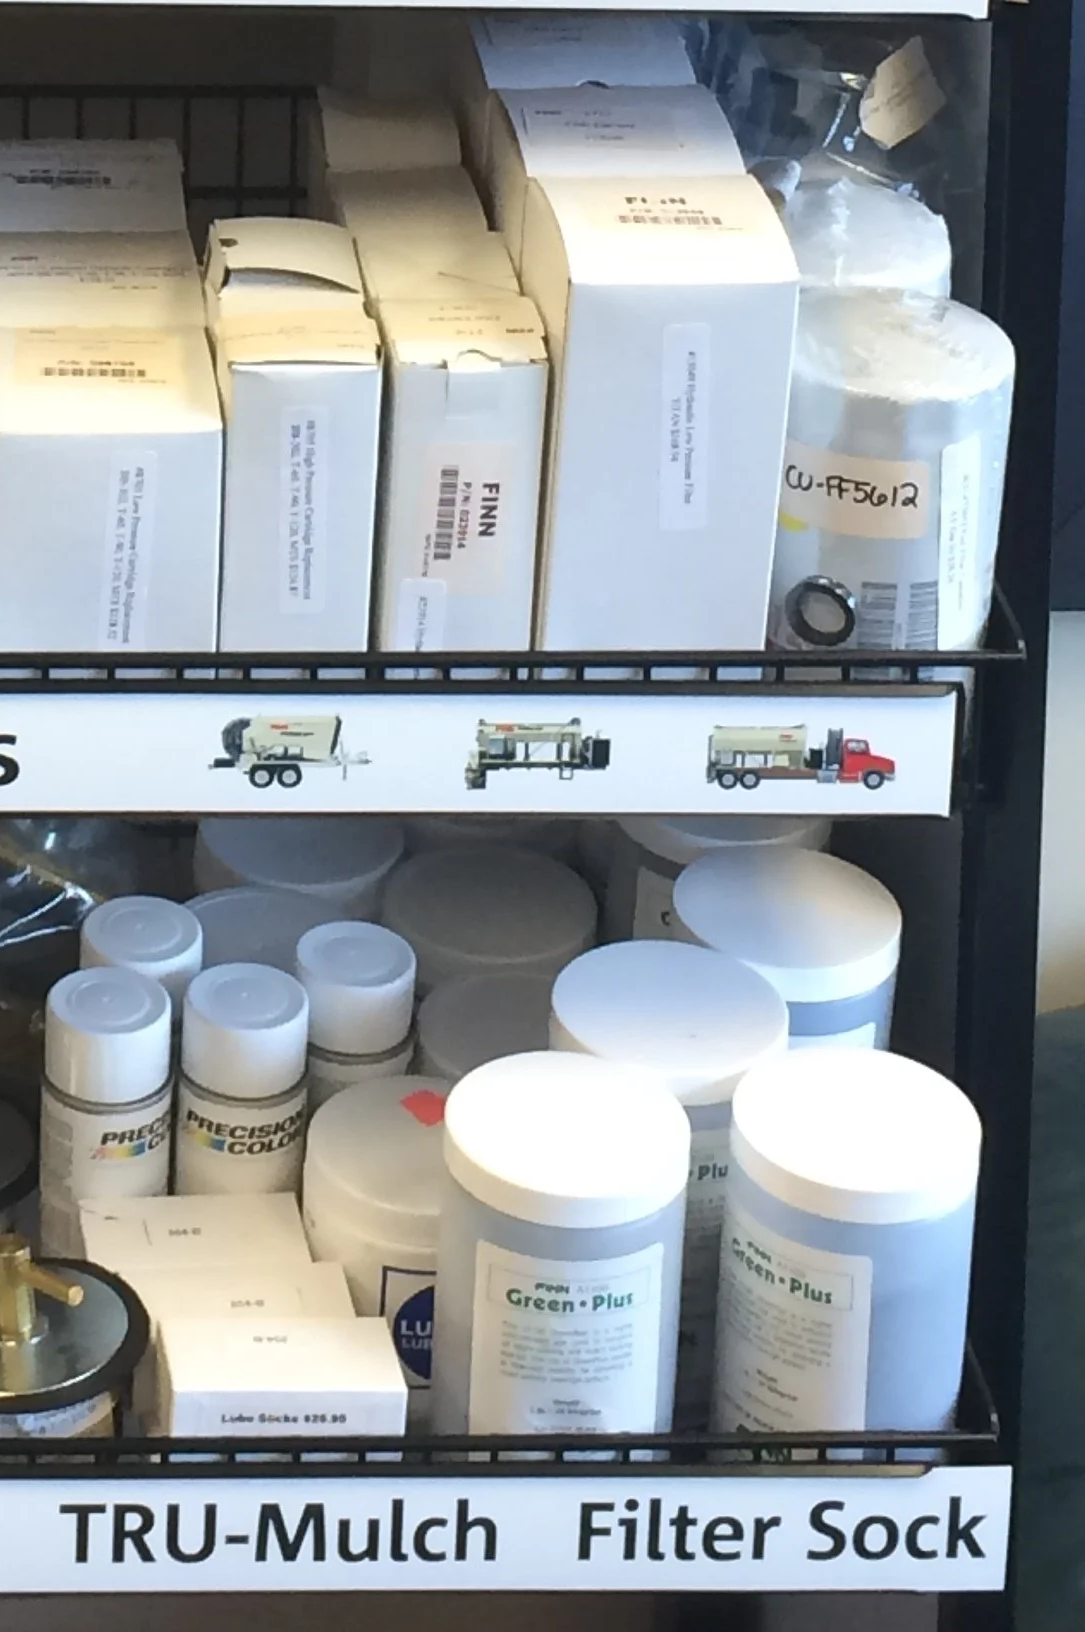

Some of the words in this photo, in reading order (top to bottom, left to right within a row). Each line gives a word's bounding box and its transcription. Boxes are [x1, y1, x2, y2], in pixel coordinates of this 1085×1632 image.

[478, 481, 501, 538] FINN
[697, 1162, 729, 1181] Plu
[505, 1287, 576, 1313] Green
[591, 1292, 634, 1312] Plus
[789, 1276, 833, 1306] Plus
[59, 1499, 499, 1564] TRU-Mulch
[576, 1497, 783, 1561] Filter
[806, 1496, 989, 1561] Sock
